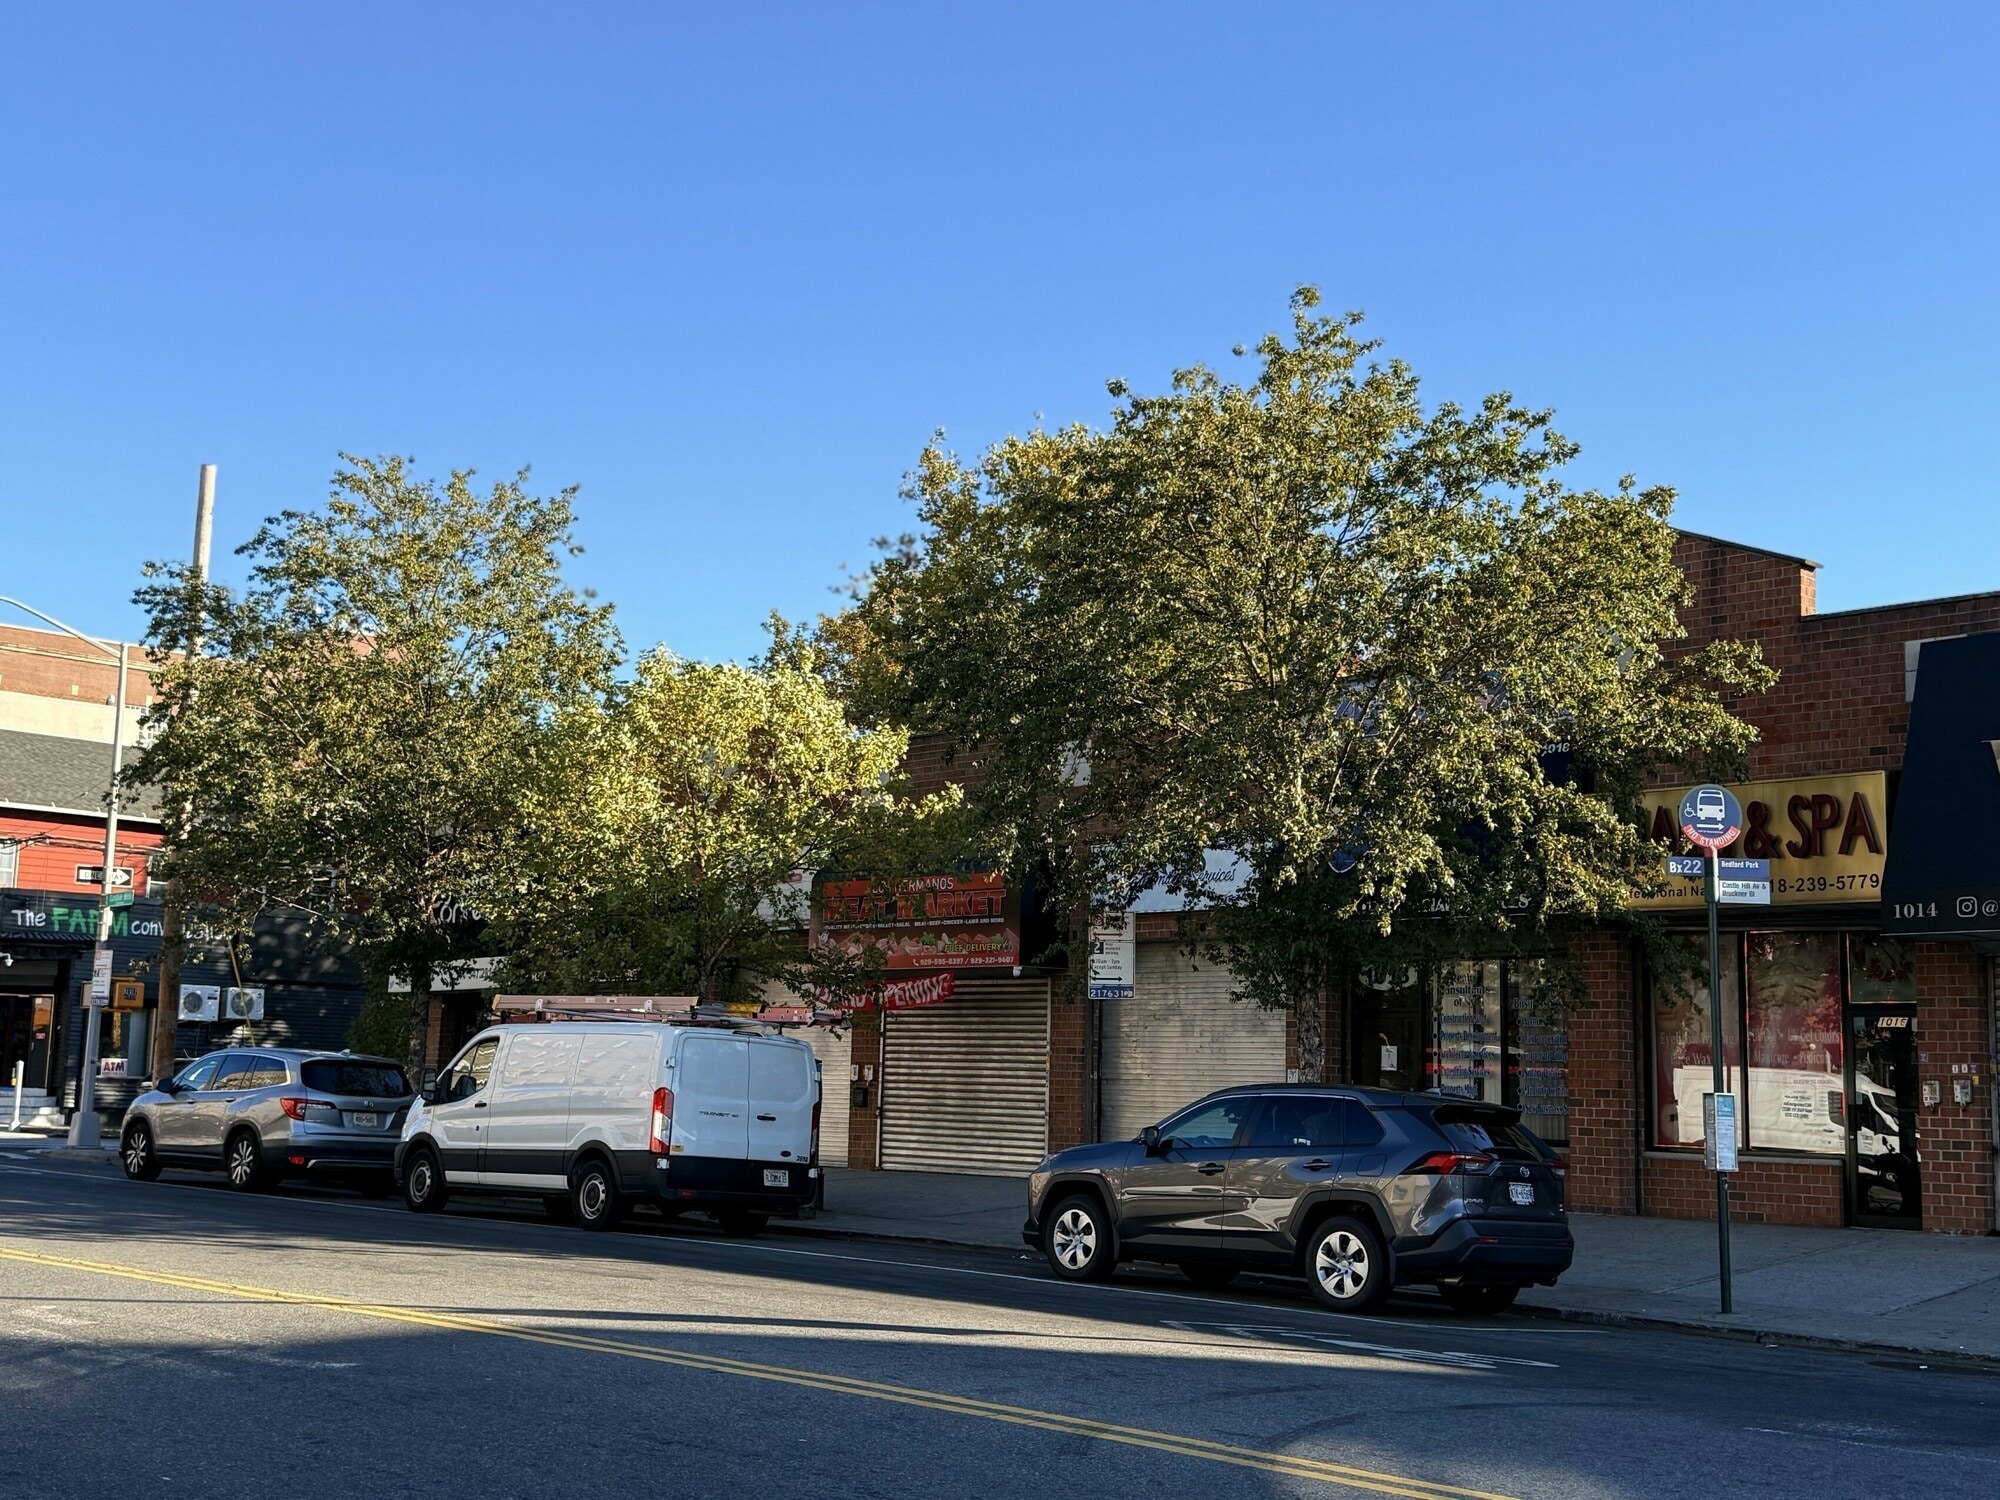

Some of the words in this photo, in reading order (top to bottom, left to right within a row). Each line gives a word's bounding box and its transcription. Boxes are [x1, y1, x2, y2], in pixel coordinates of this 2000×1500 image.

[1743, 801, 1780, 858] &
[1786, 791, 1884, 859] SPA
[1686, 825, 1699, 841] NO
[1699, 828, 1737, 847] STANDING
[1669, 859, 1702, 874] Bx22
[1721, 861, 1745, 869] Bedford
[1745, 861, 1760, 869] Park
[1770, 873, 1880, 894] 18-239-5779
[896, 889, 1007, 919] MARKET
[1893, 902, 1939, 919] 1014
[10, 908, 46, 927] The
[944, 944, 964, 952] FREE
[965, 943, 1002, 952] DELIVERY
[1093, 942, 1101, 954] 2
[1090, 989, 1124, 998] 217631
[1800, 1029, 1814, 1042] Gel
[1814, 1028, 1840, 1043] Colors
[103, 1061, 125, 1072] ATM
[699, 1110, 730, 1118] TRANSIT
